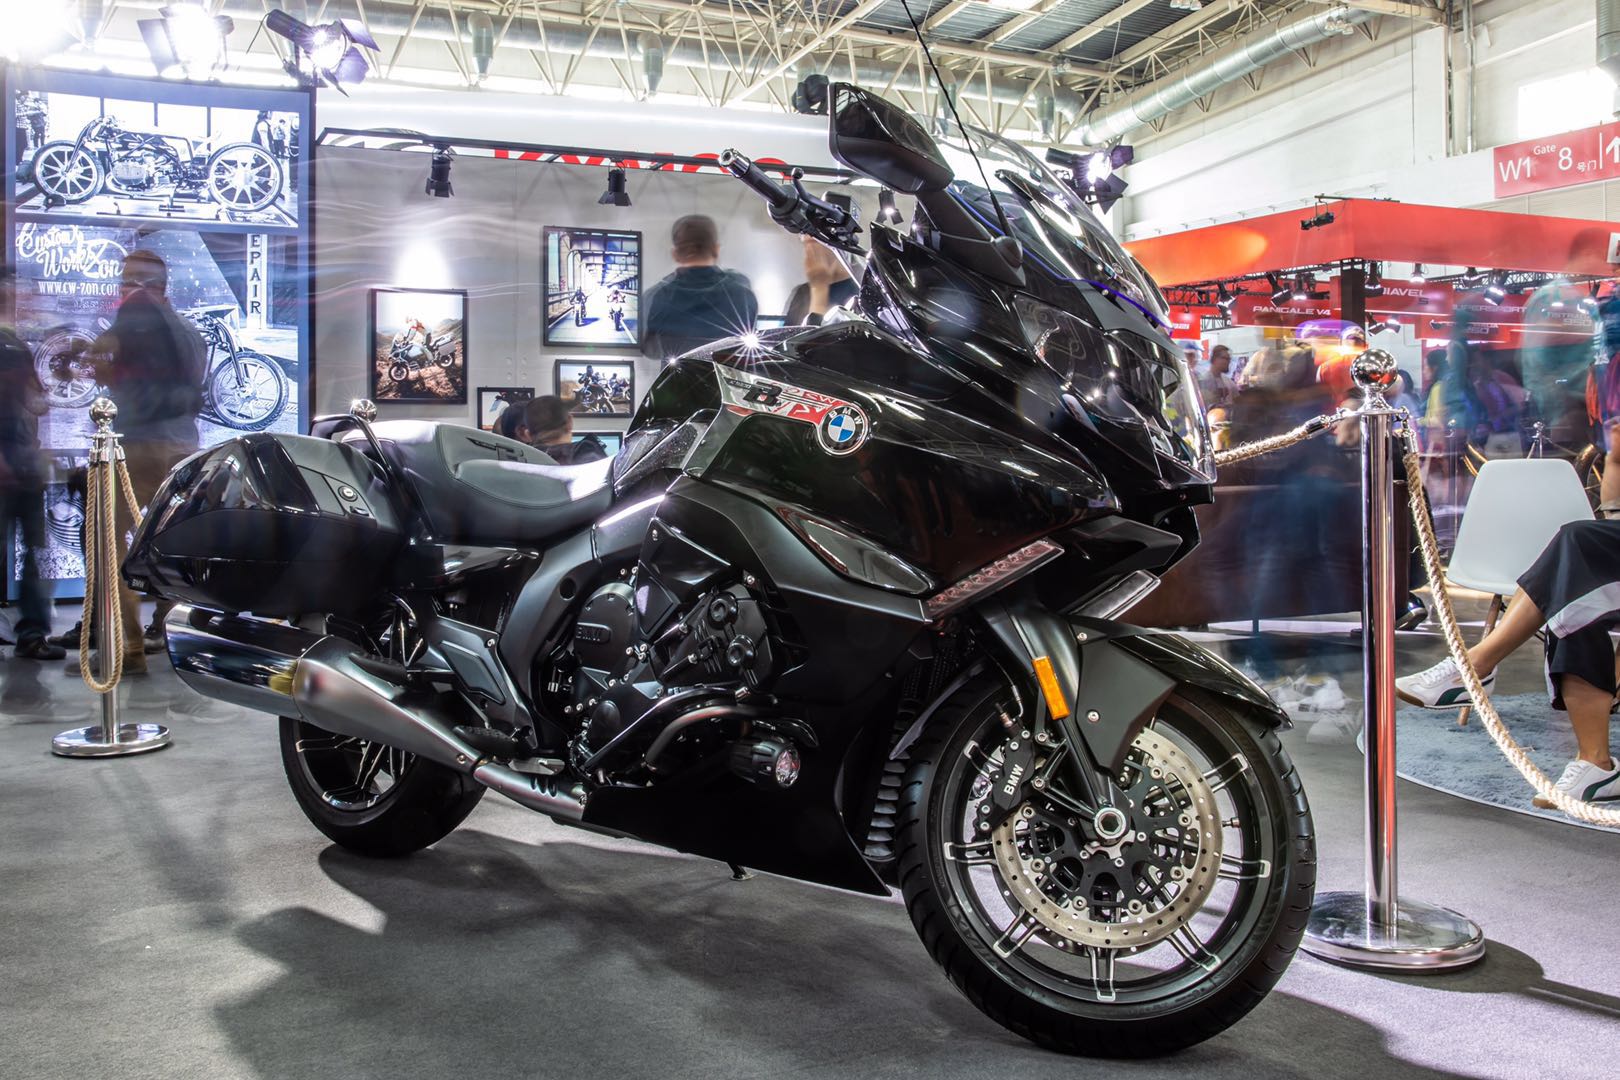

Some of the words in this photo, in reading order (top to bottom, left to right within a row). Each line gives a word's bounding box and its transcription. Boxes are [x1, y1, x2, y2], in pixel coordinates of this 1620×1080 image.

[1498, 156, 1532, 183] W1
[1533, 144, 1557, 156] Gate
[1558, 146, 1574, 171] 8
[1576, 159, 1597, 173] 号门
[1252, 305, 1314, 315] PANIGALE
[1316, 308, 1332, 316] V4
[828, 406, 864, 425] BMW
[1003, 763, 1024, 796] BMW
